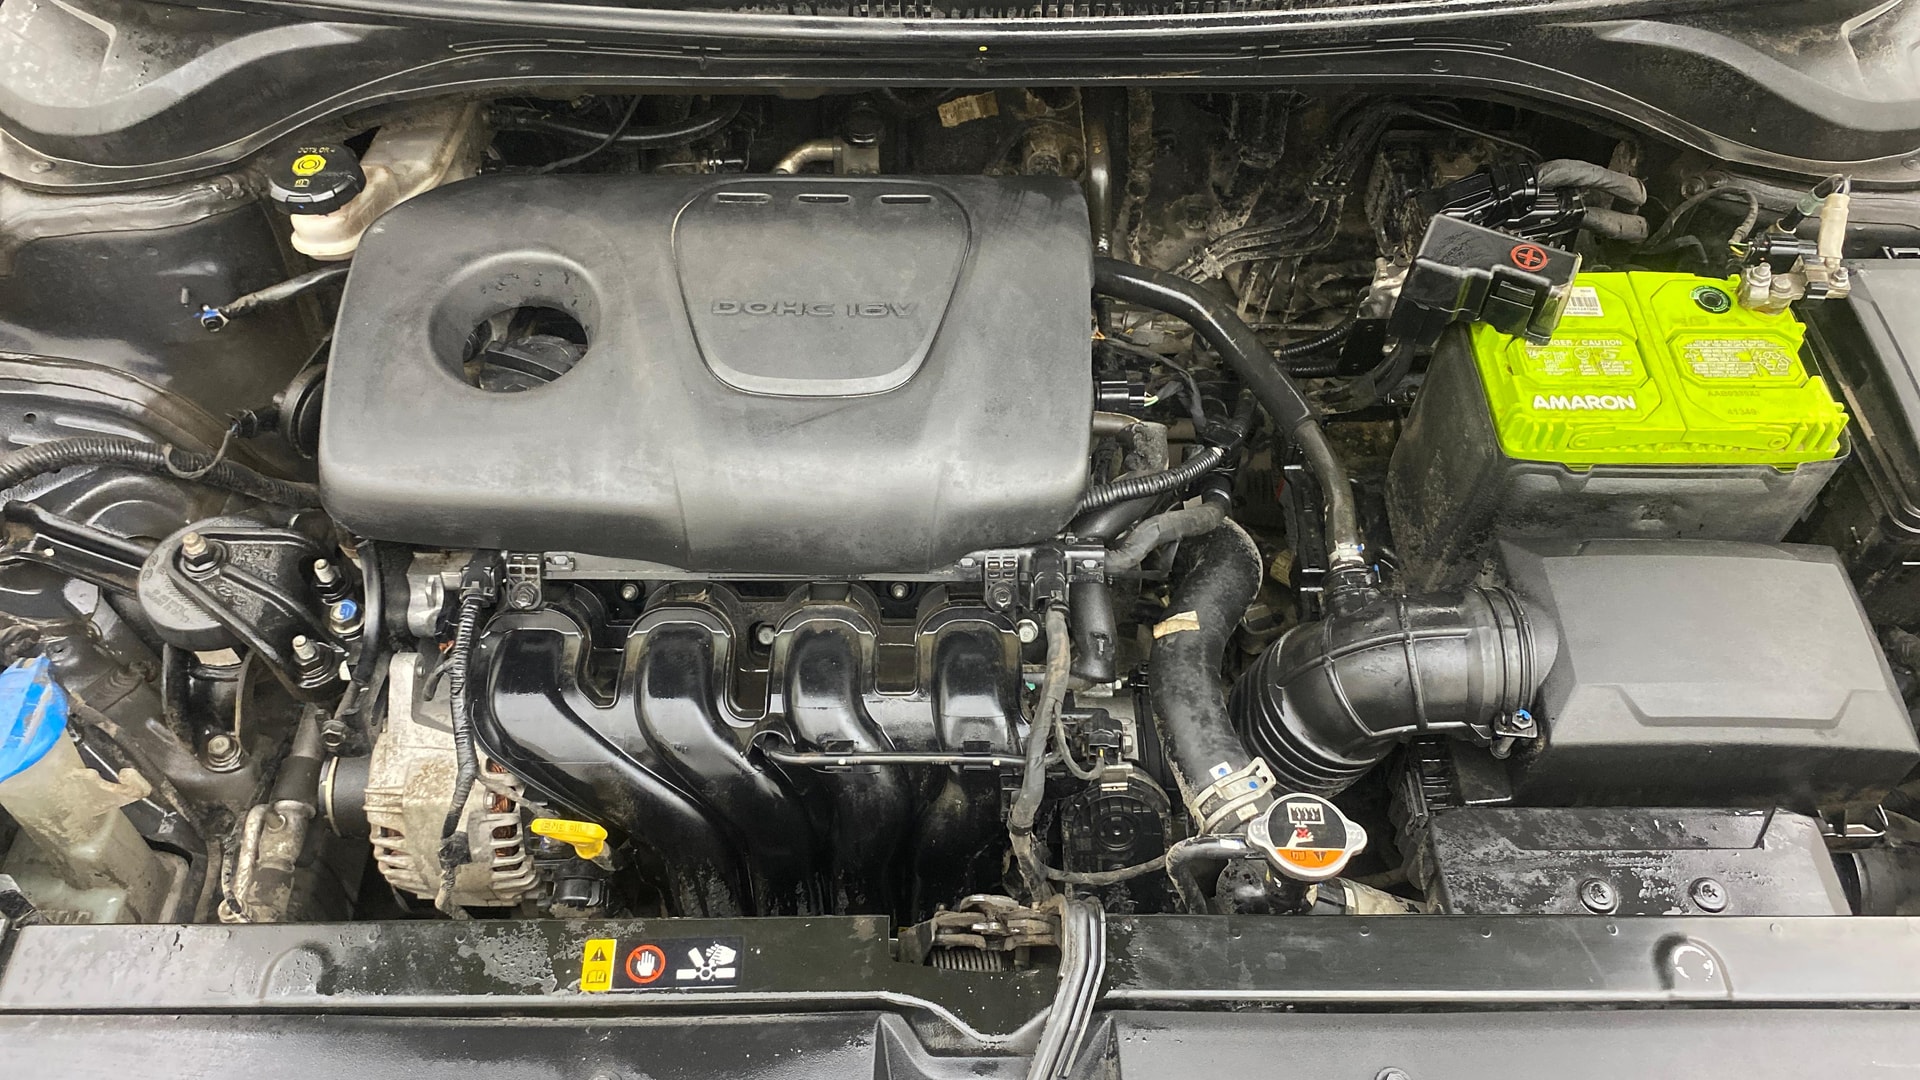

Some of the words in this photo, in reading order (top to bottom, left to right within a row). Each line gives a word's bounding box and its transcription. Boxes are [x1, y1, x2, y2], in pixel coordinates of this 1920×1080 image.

[711, 301, 835, 317] DOHC
[847, 302, 918, 318] 16V
[1533, 395, 1637, 410] AMARON
